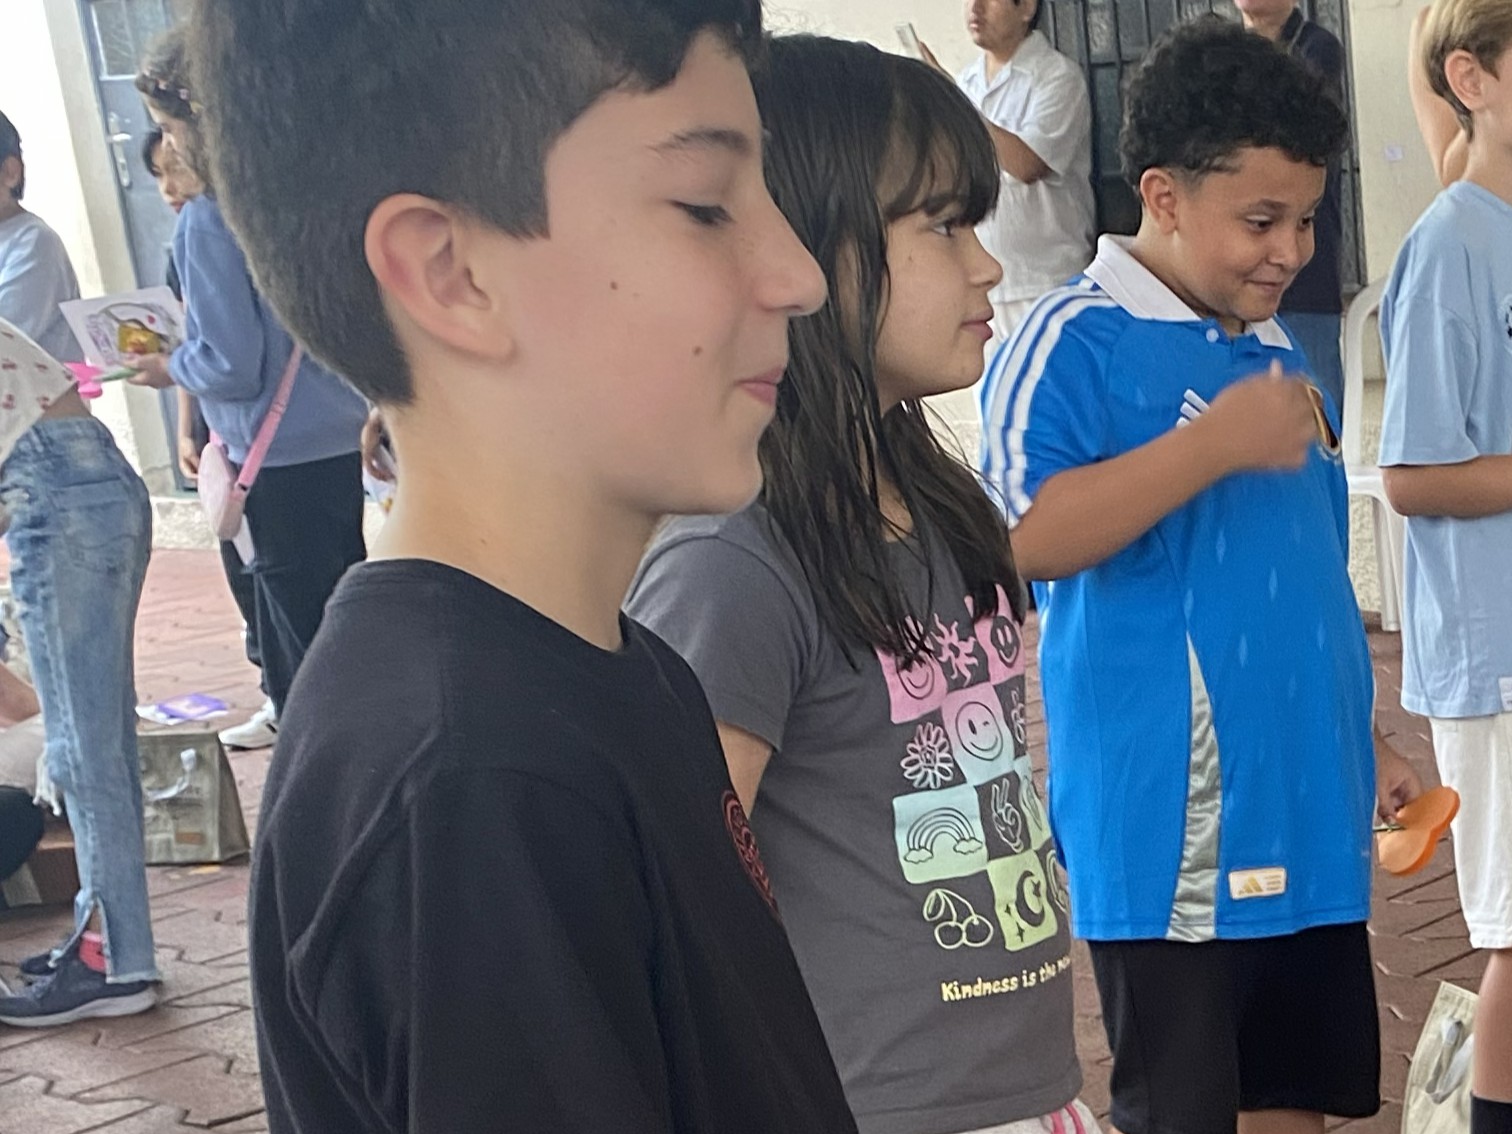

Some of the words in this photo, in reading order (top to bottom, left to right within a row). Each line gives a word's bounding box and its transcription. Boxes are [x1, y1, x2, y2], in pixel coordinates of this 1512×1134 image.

[941, 976, 1018, 1001] Kindness
[1022, 970, 1037, 988] is
[1039, 961, 1057, 983] the
